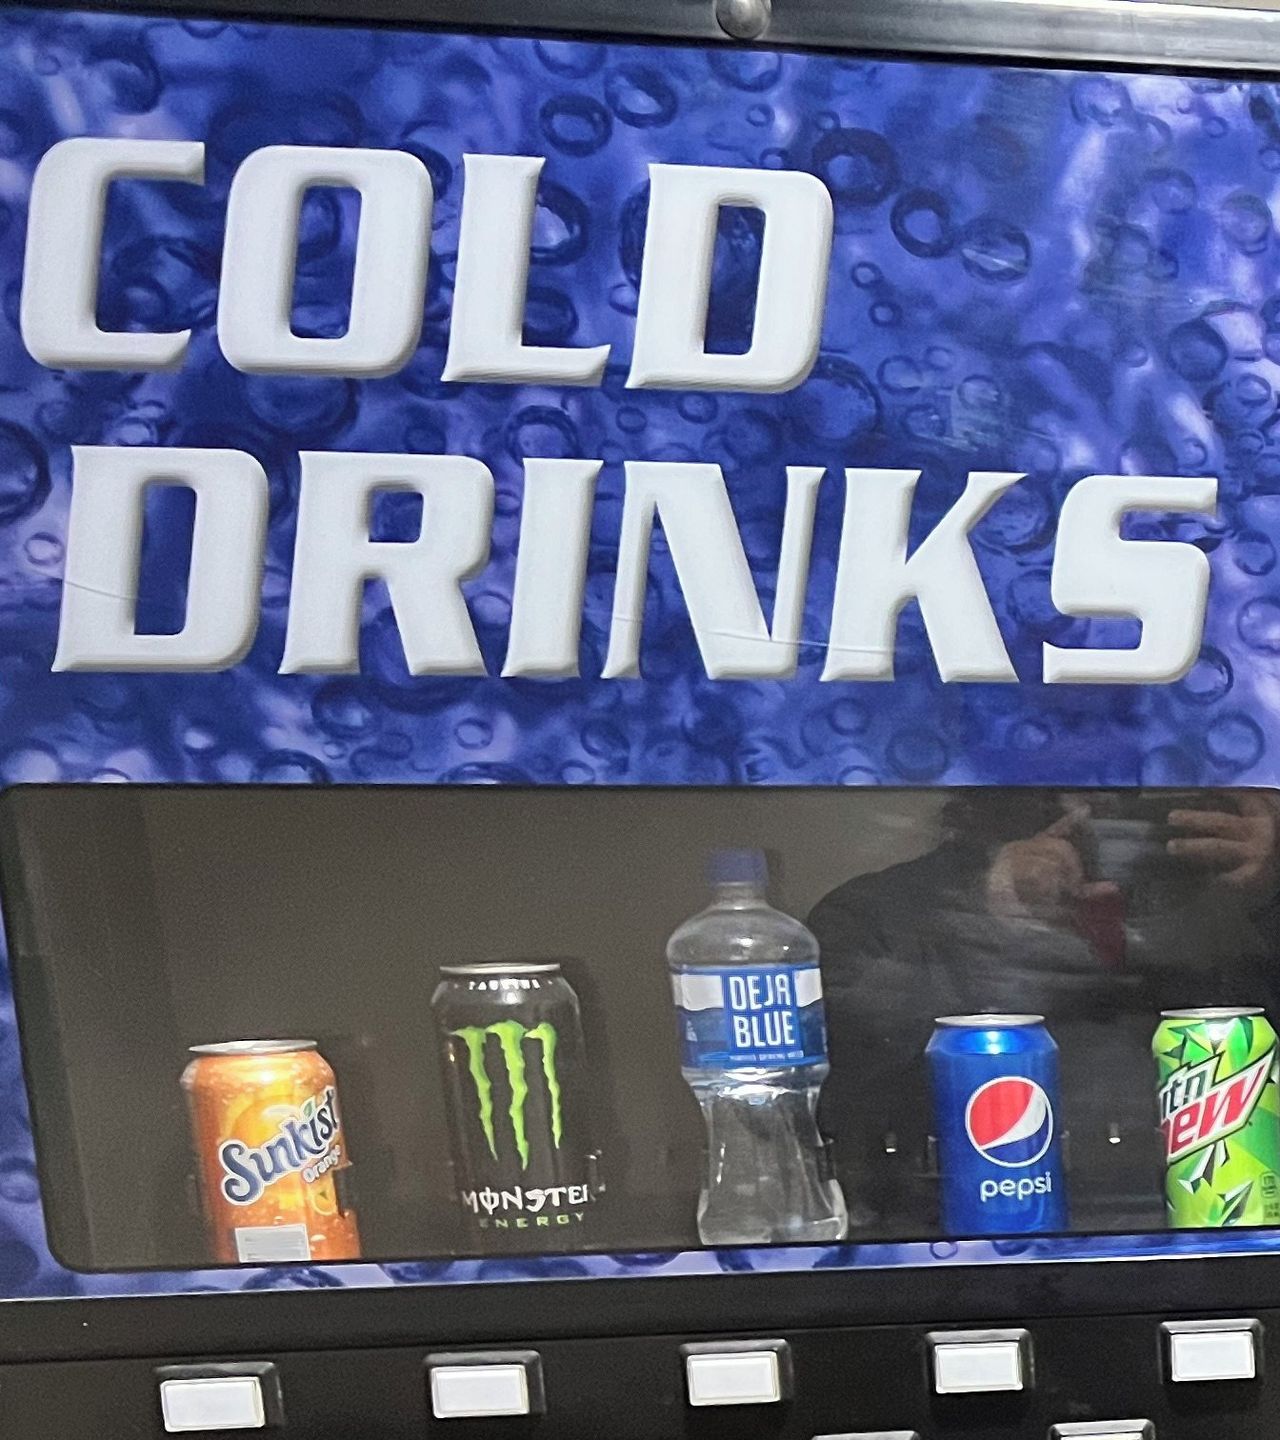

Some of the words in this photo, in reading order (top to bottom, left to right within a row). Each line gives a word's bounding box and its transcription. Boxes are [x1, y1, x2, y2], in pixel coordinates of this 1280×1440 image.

[20, 137, 834, 394] COLD
[52, 445, 1218, 684] DRINKS
[729, 974, 791, 1010] DEJA
[733, 1011, 795, 1048] BLUE
[1162, 1070, 1208, 1120] tn
[1162, 1062, 1267, 1155] ew
[219, 1087, 339, 1204] Sunkist
[979, 1171, 1052, 1202] pepsi
[479, 1212, 584, 1228] ENERGY
